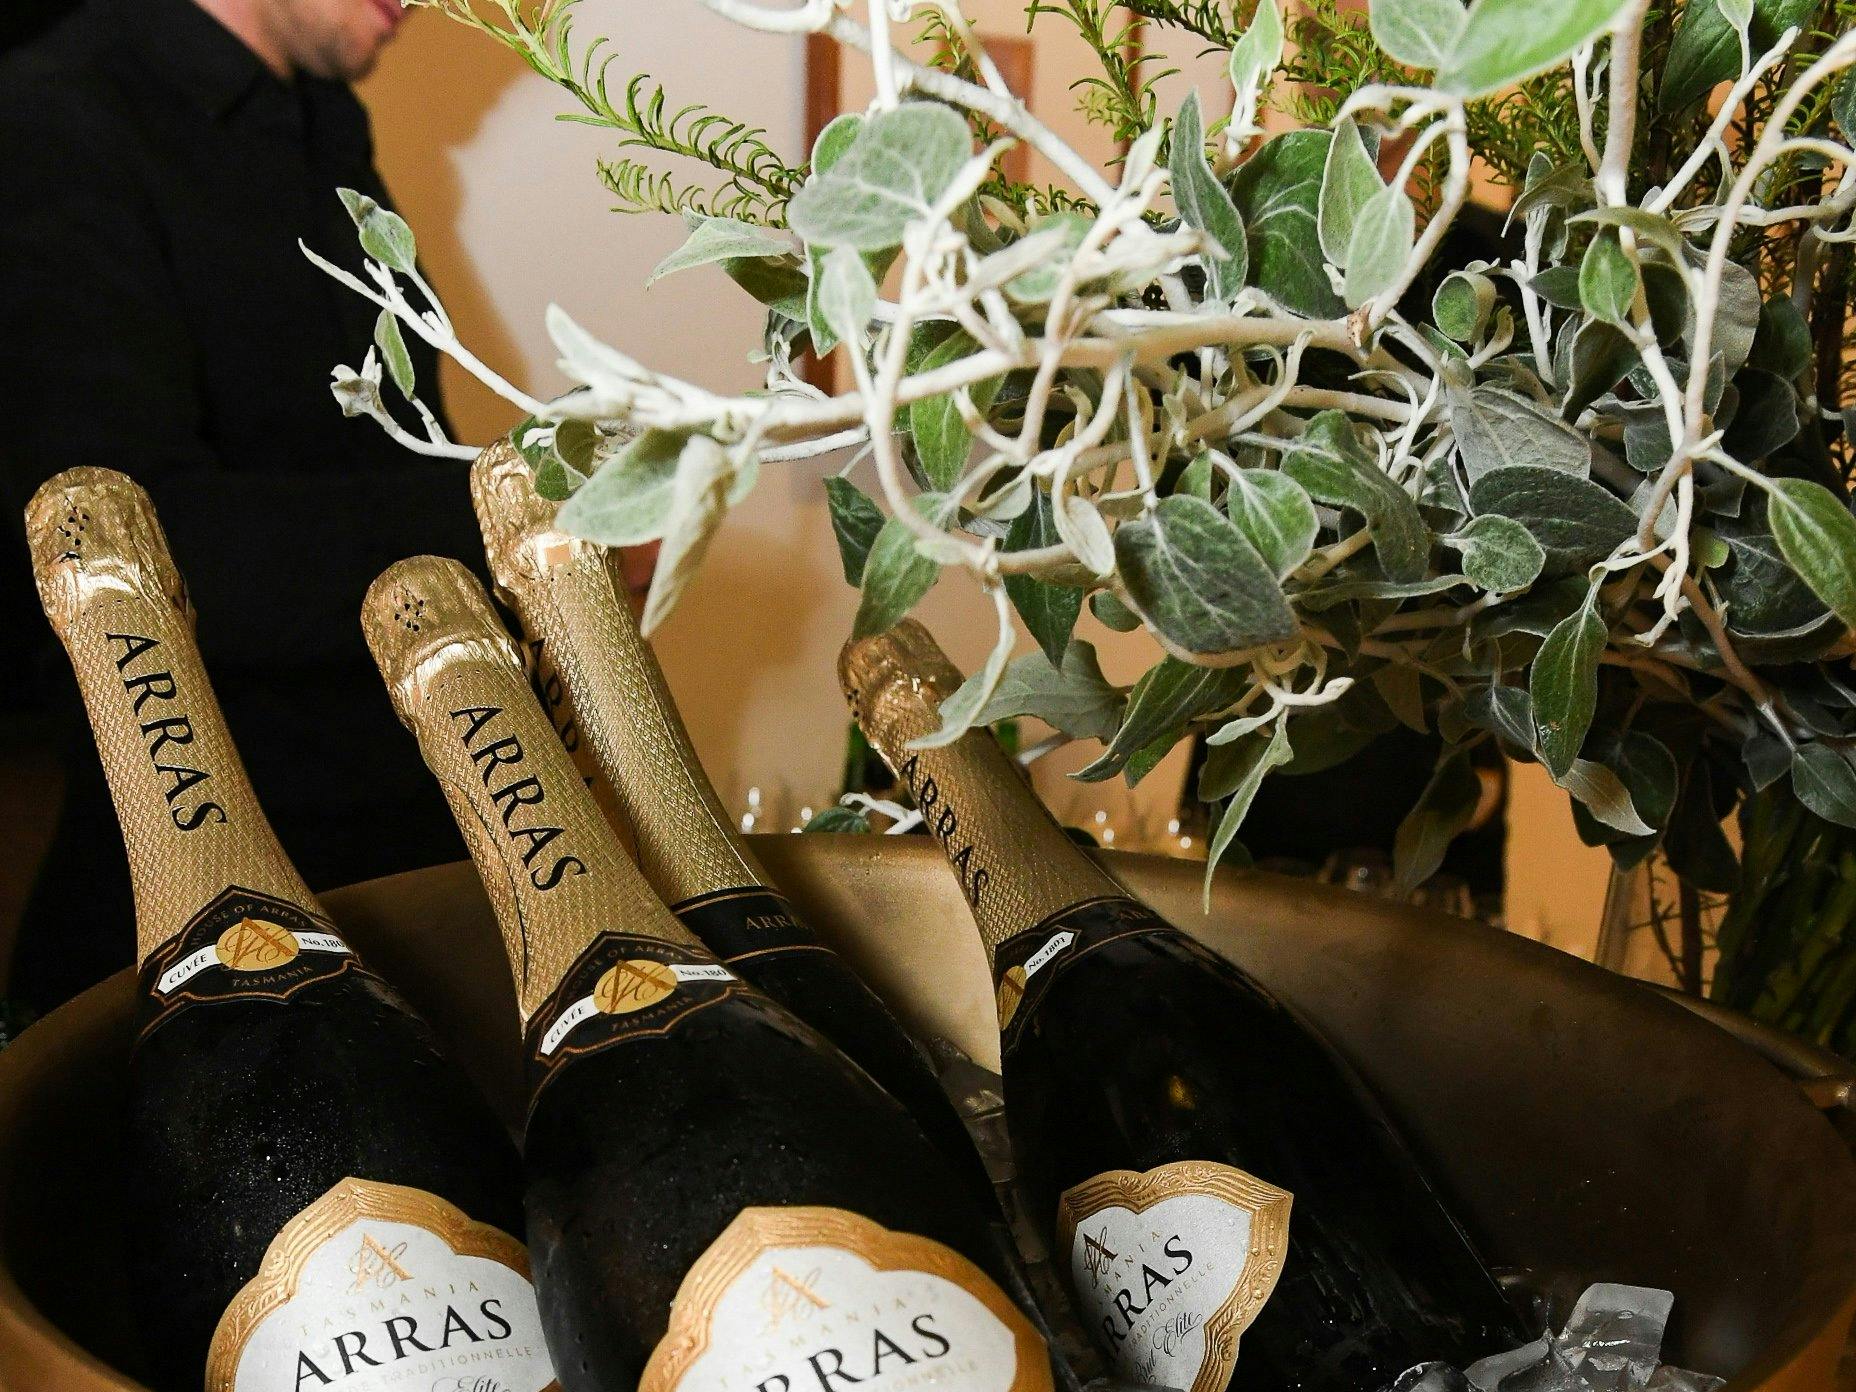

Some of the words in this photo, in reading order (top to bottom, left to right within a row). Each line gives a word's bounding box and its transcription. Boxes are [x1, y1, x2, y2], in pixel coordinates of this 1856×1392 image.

[104, 632, 228, 832] ARRAS
[449, 706, 587, 891] ARRAS
[168, 951, 208, 984] CUVÉE
[231, 965, 314, 988] TASMANIA
[1103, 1234, 1194, 1360] RRAS
